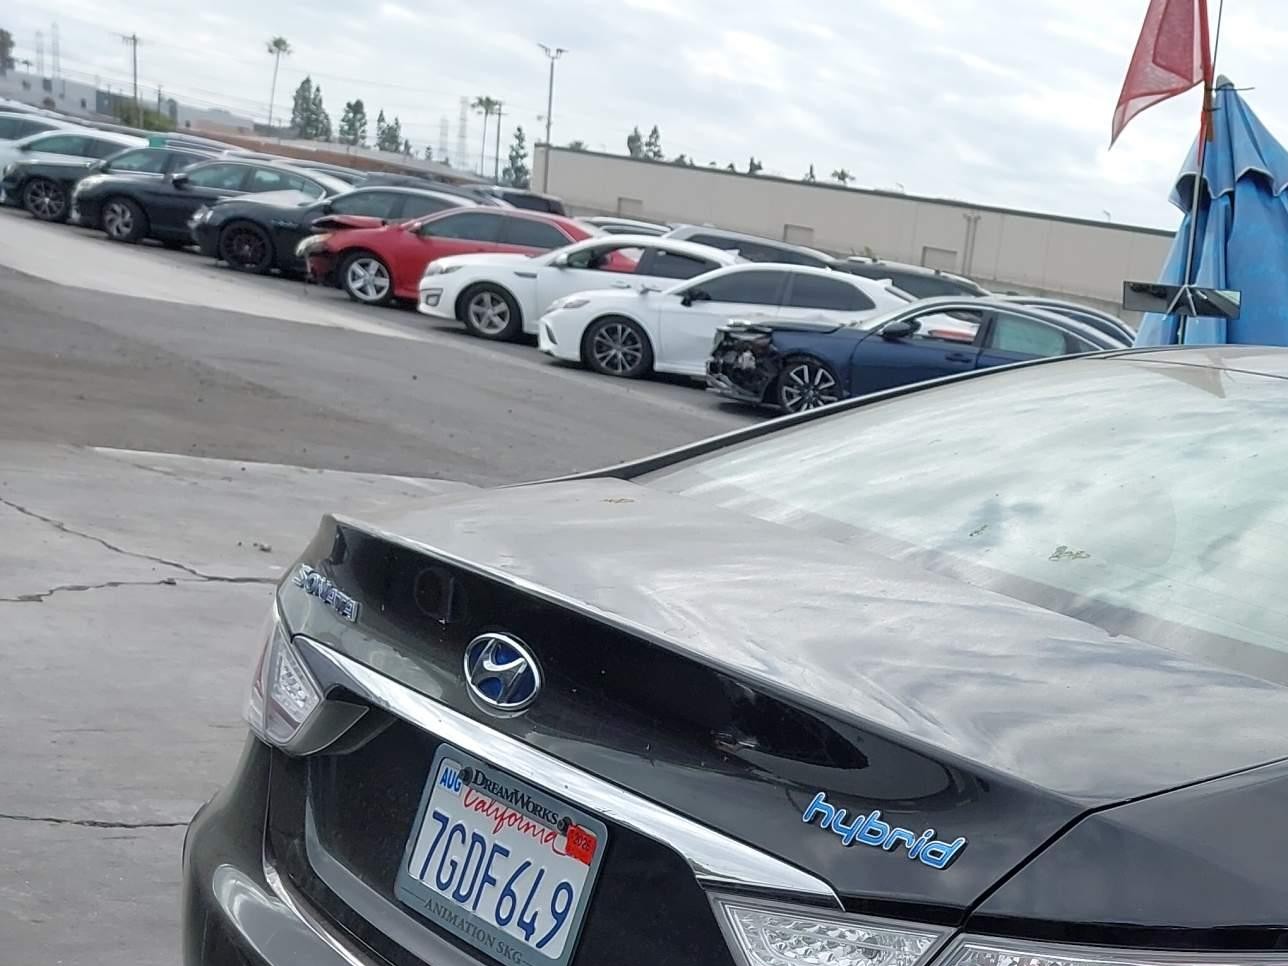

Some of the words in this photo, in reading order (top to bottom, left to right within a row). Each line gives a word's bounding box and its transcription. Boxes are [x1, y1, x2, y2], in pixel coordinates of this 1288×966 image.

[439, 766, 462, 793] AUG
[463, 786, 560, 846] California
[802, 791, 967, 870] hybrid
[418, 810, 574, 949] 7GDF649
[423, 898, 497, 949] ANIMATION
[497, 940, 522, 965] SKG
